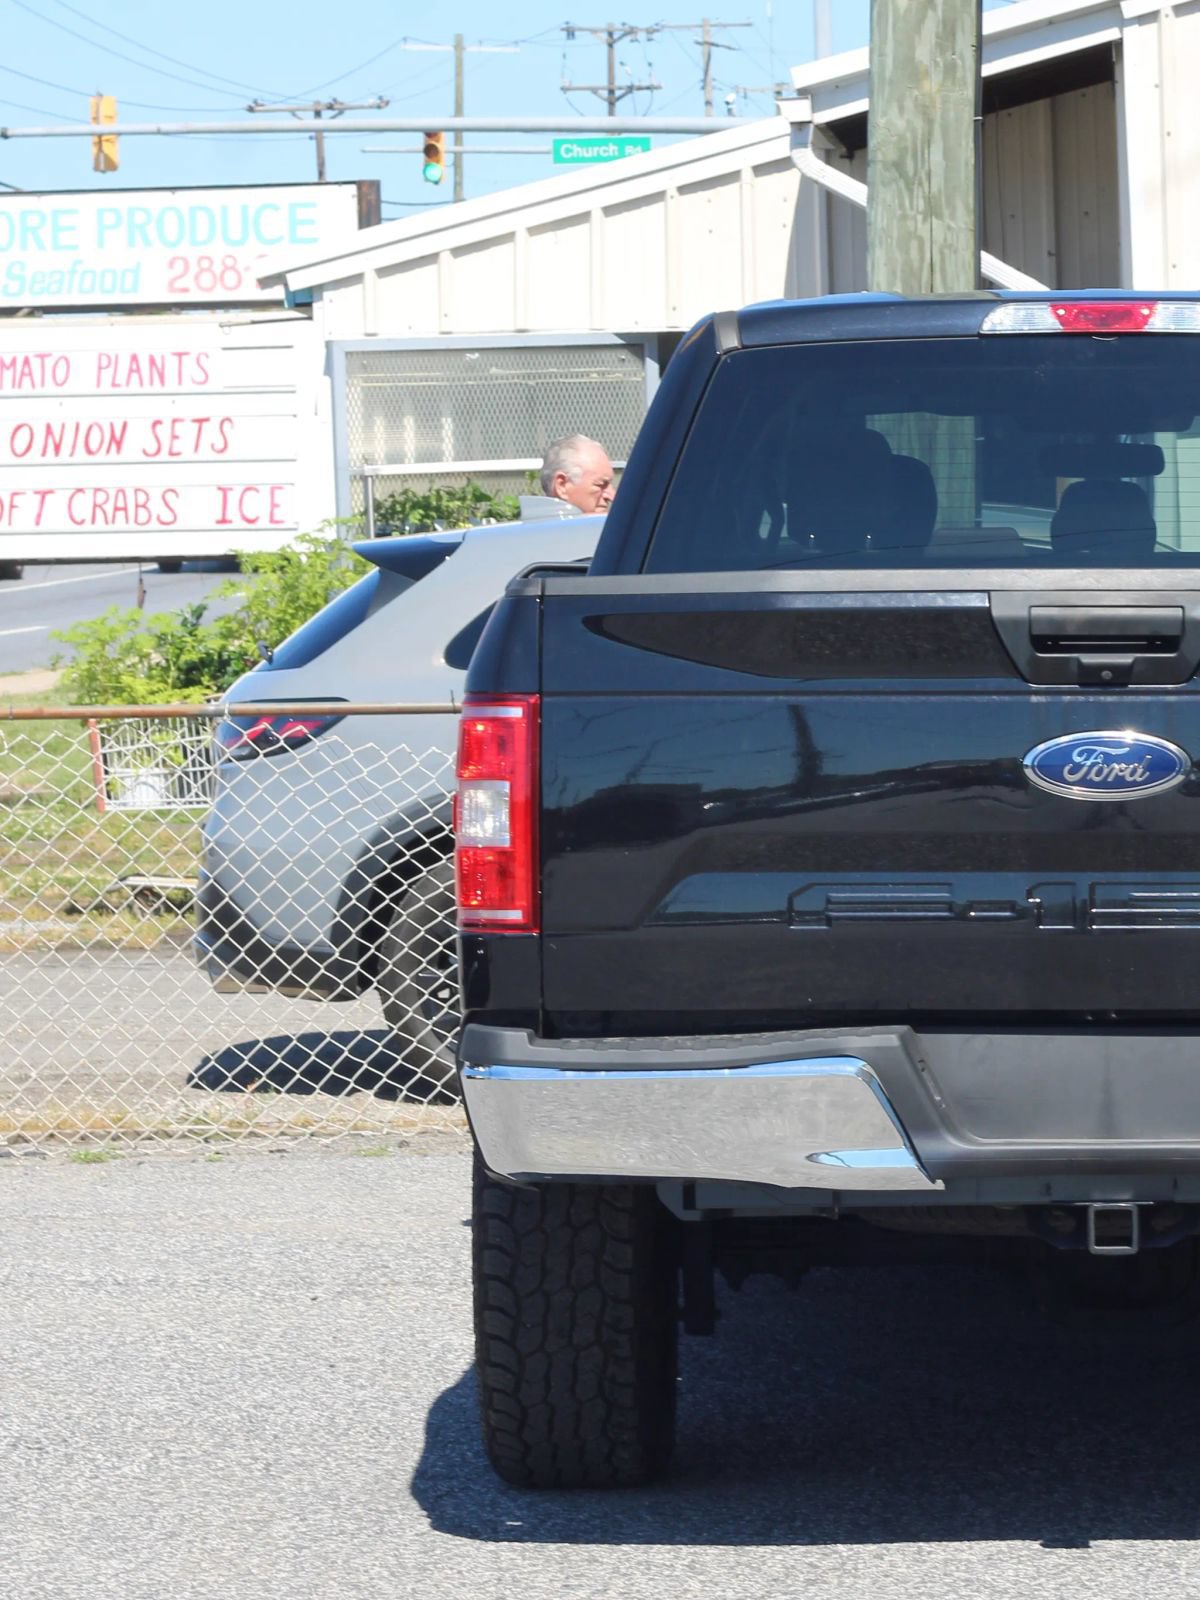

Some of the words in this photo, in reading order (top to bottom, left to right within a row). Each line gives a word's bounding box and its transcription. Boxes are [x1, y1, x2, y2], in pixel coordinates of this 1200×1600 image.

[561, 143, 619, 158] Church
[96, 202, 319, 250] PRODUCE
[2, 259, 141, 297] Seafood
[0, 353, 70, 389] MATO
[96, 352, 209, 388] PLANTS
[10, 420, 128, 458] ONION
[143, 417, 234, 457] SETS
[0, 490, 55, 526] FT
[68, 488, 180, 526] CRABS
[215, 486, 285, 525] ICE
[1063, 745, 1152, 783] Ford
